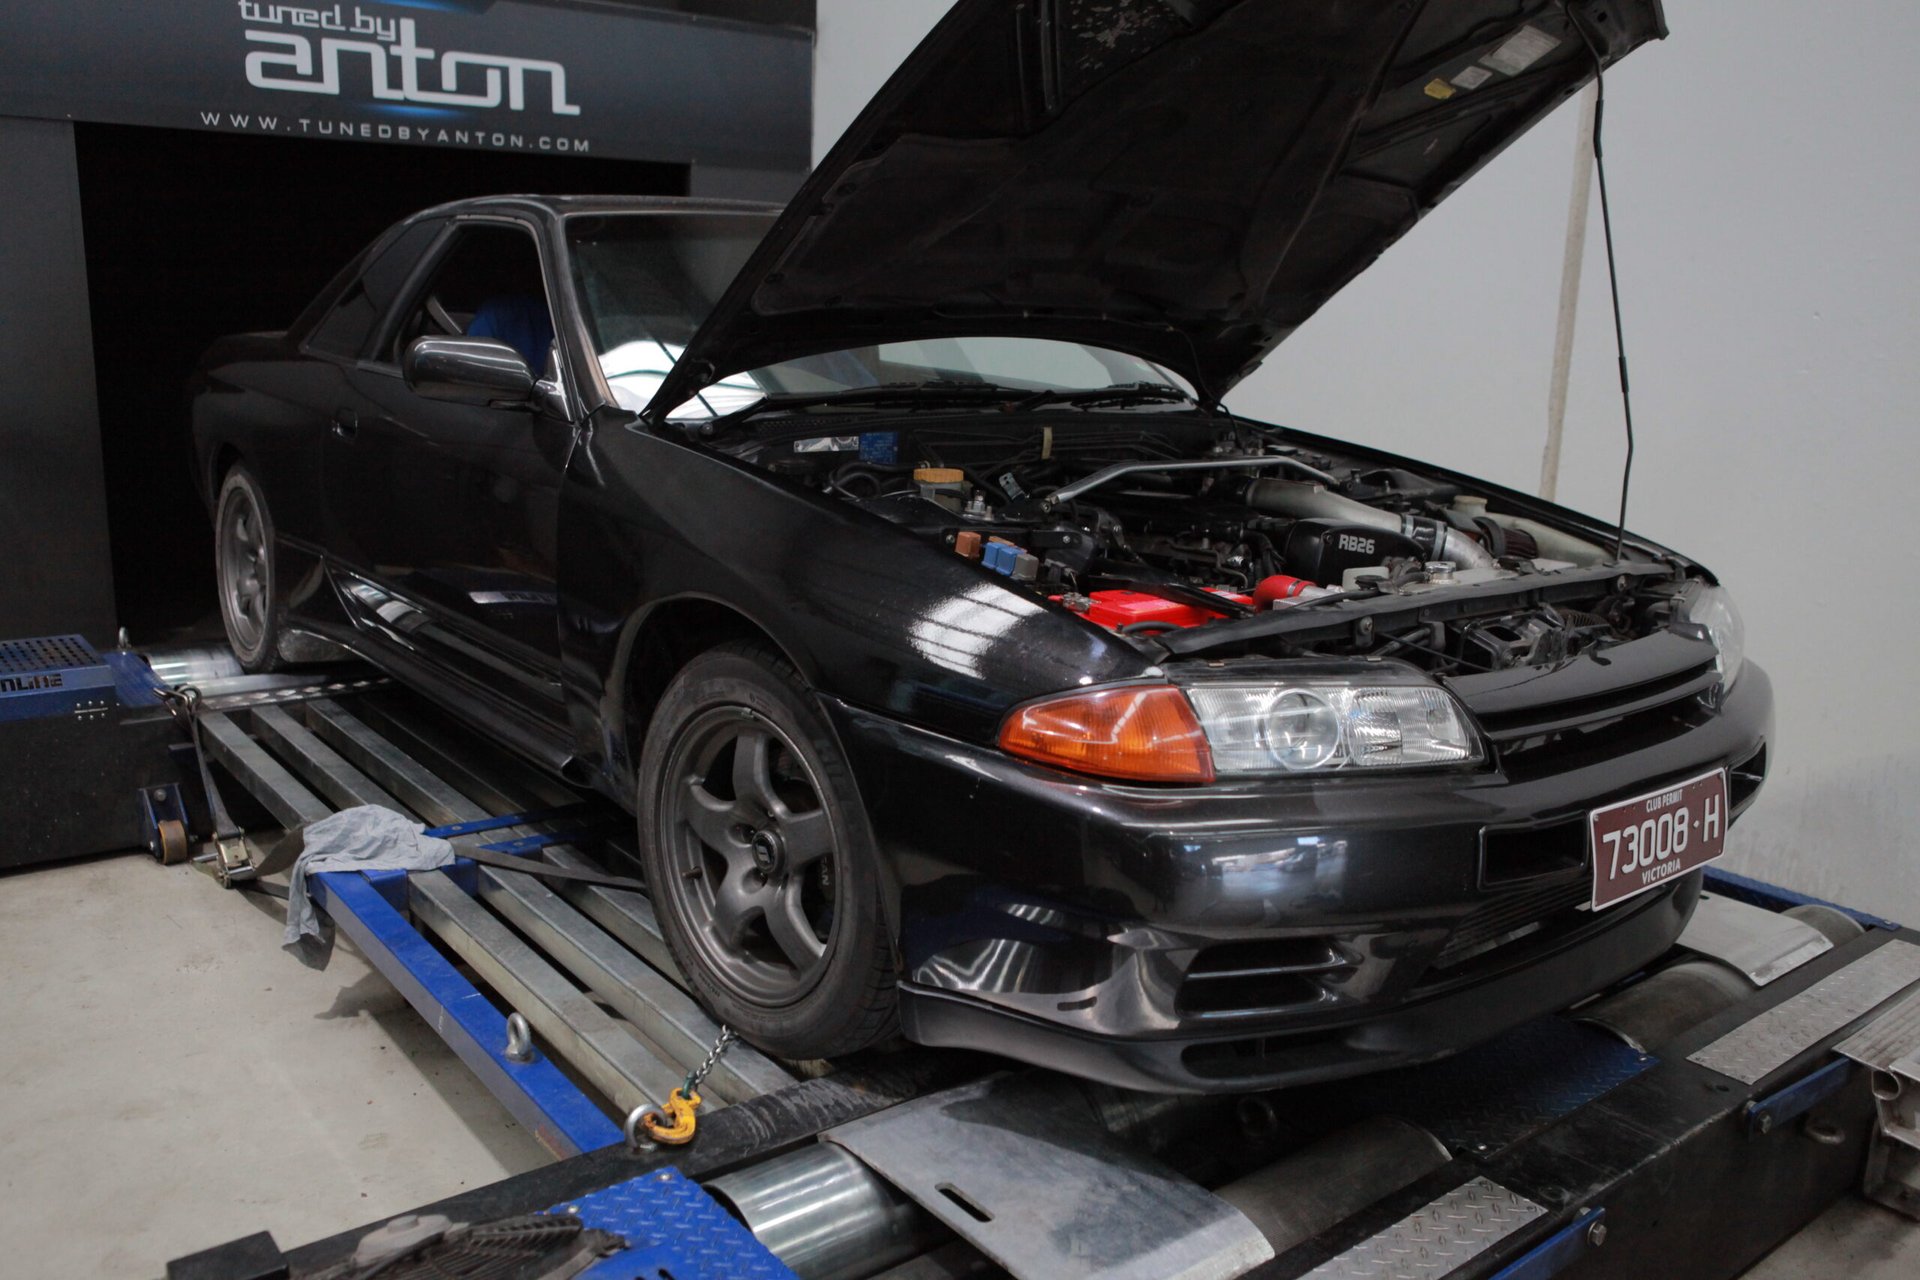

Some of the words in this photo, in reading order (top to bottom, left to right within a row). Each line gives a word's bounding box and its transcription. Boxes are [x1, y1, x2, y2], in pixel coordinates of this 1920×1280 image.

[238, 0, 346, 31] tuned
[349, 6, 396, 41] by
[245, 18, 581, 115] anton
[201, 111, 590, 152] WWW.TUNEDBYANTON.COM
[1338, 534, 1375, 555] RB26
[1646, 797, 1662, 813] CLUB
[1642, 858, 1681, 885] VICTORIA
